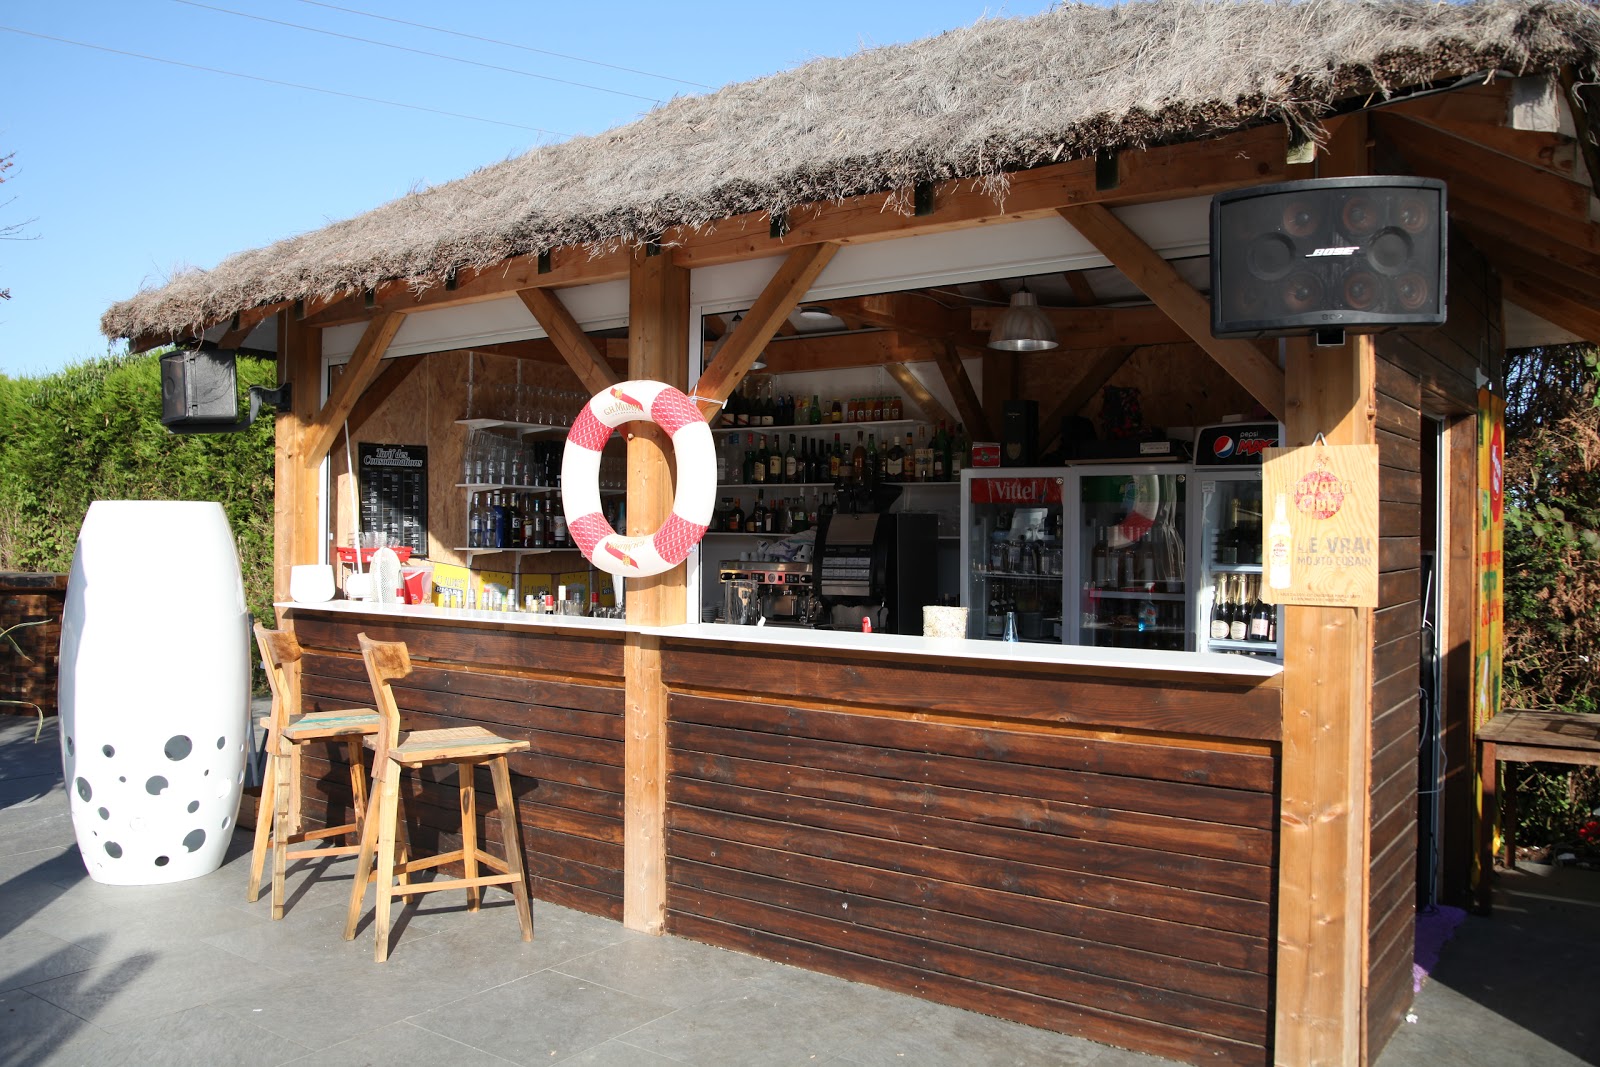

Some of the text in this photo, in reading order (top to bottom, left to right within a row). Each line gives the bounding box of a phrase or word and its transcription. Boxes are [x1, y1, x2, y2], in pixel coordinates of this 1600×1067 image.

[1305, 246, 1360, 258] BOSE
[994, 480, 1037, 499] Vittel
[1298, 537, 1318, 554] LE
[1327, 537, 1371, 554] VRAI
[1298, 556, 1333, 566] MOJITO
